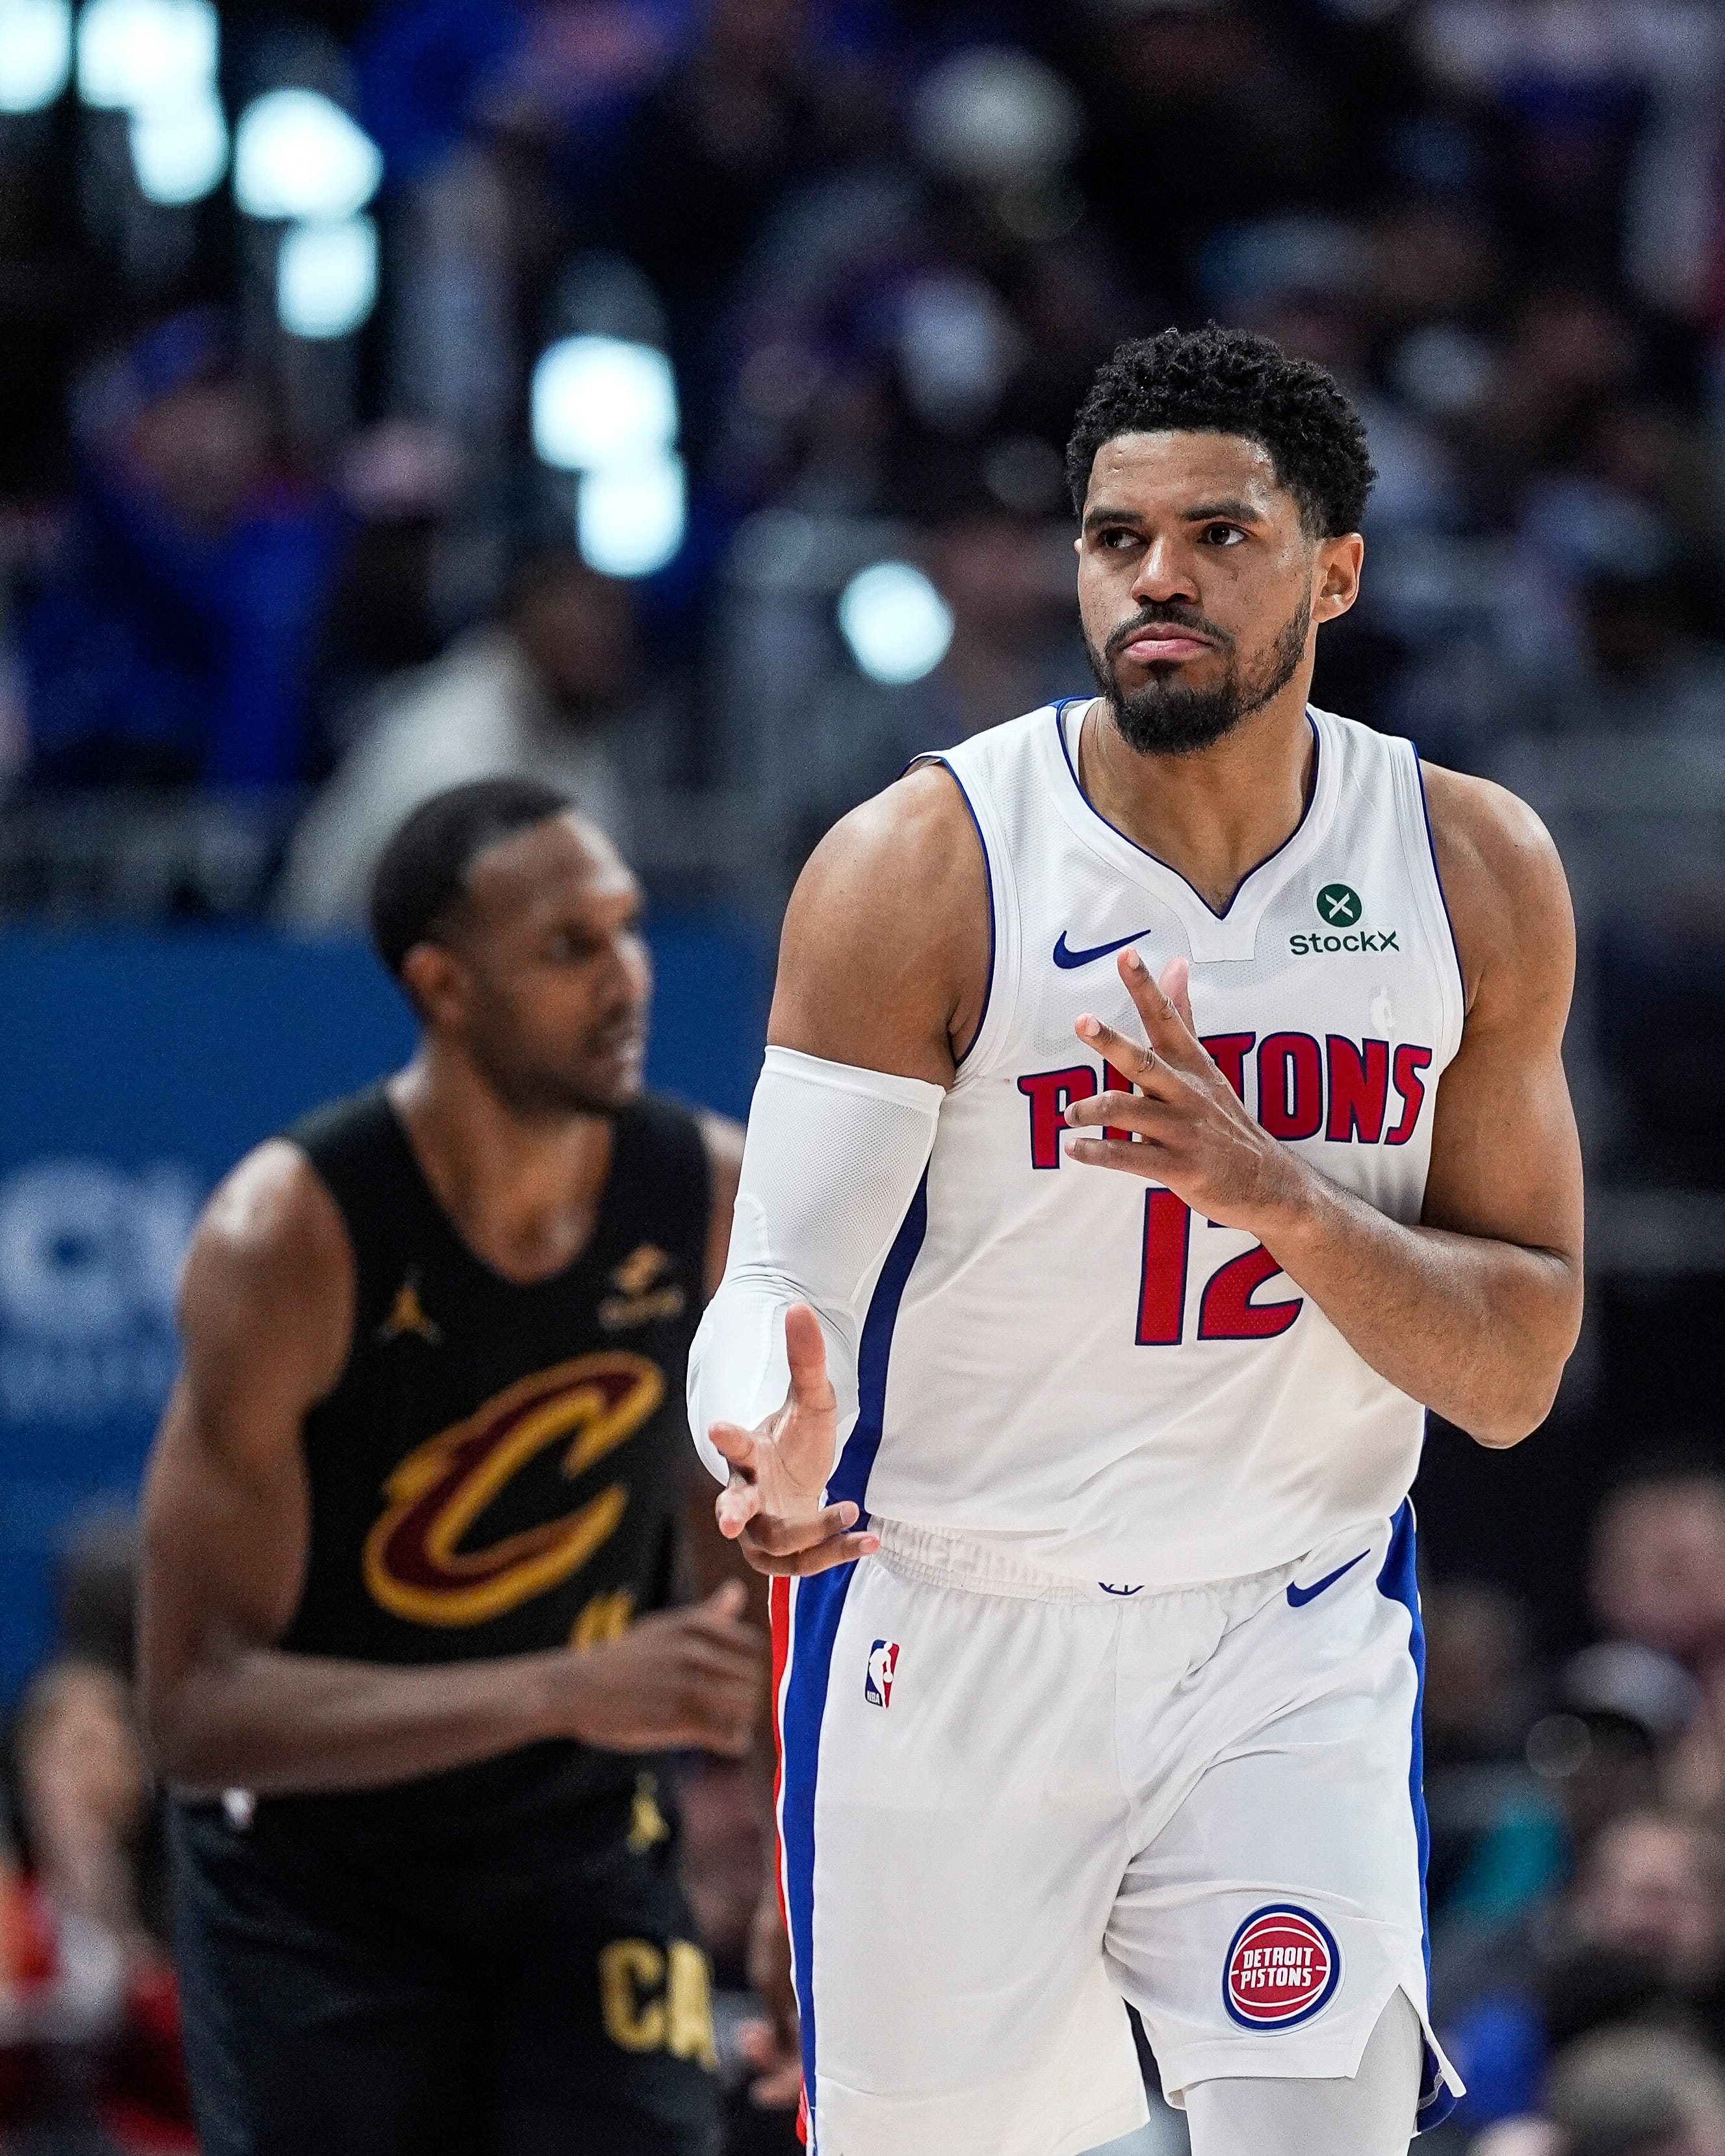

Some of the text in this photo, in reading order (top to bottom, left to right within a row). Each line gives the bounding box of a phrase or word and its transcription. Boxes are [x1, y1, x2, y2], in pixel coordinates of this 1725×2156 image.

[1289, 930, 1400, 955] StockX
[1243, 1947, 1314, 1970] DETROIT
[1241, 1967, 1313, 1990] PISTONS
